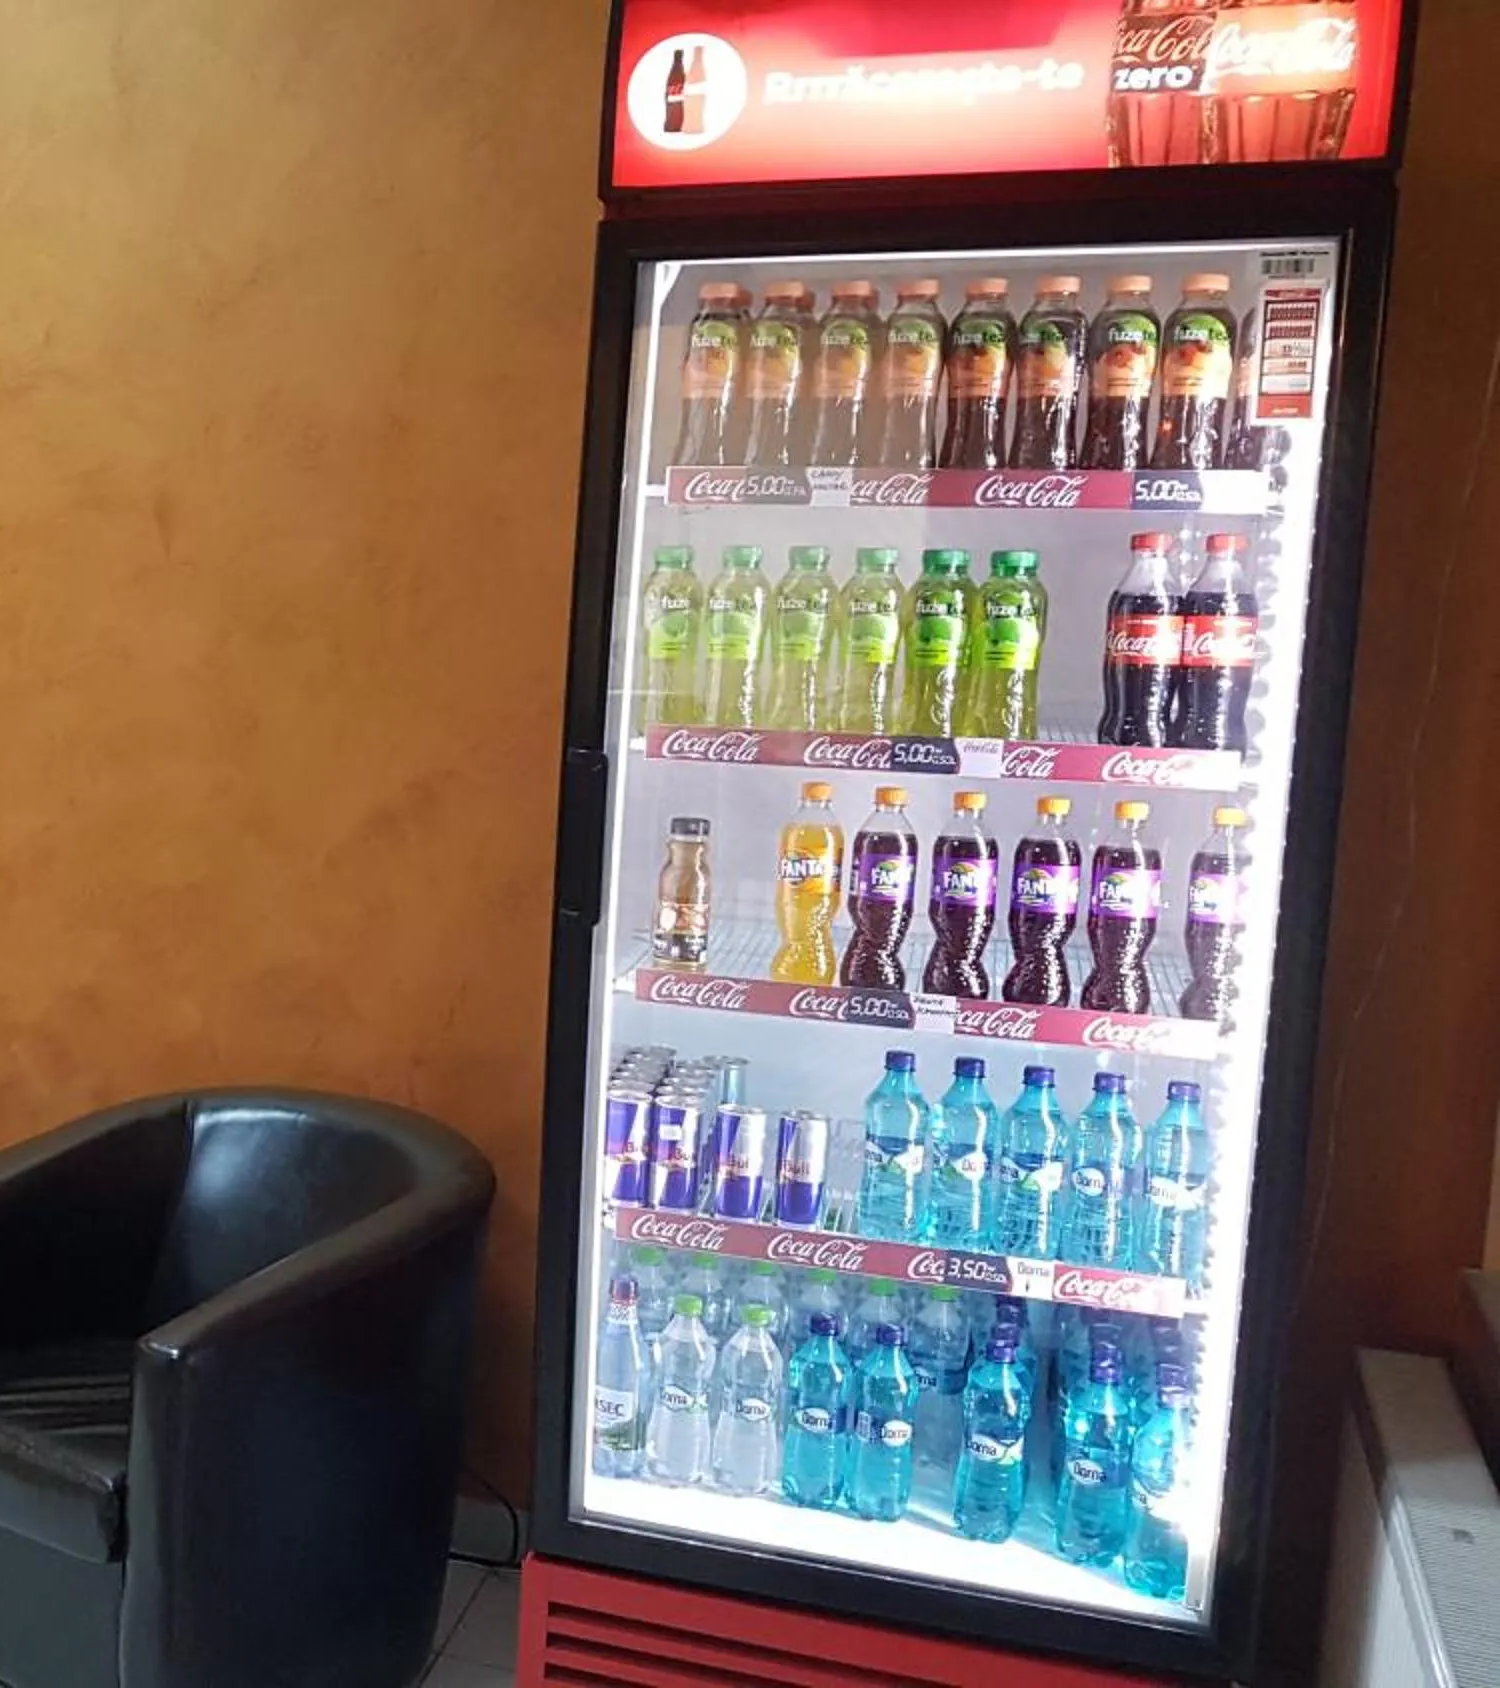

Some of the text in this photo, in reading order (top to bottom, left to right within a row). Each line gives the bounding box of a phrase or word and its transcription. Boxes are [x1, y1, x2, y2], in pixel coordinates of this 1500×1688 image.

[1114, 65, 1194, 90] zero
[975, 474, 1089, 507] Coca-Cola
[661, 729, 766, 762] Coca-Cola
[803, 735, 892, 769] Coca-Col
[651, 973, 751, 1008] Coca-Cola
[631, 1213, 728, 1251] Coca-Cola
[766, 1231, 868, 1271] Coca-Cola
